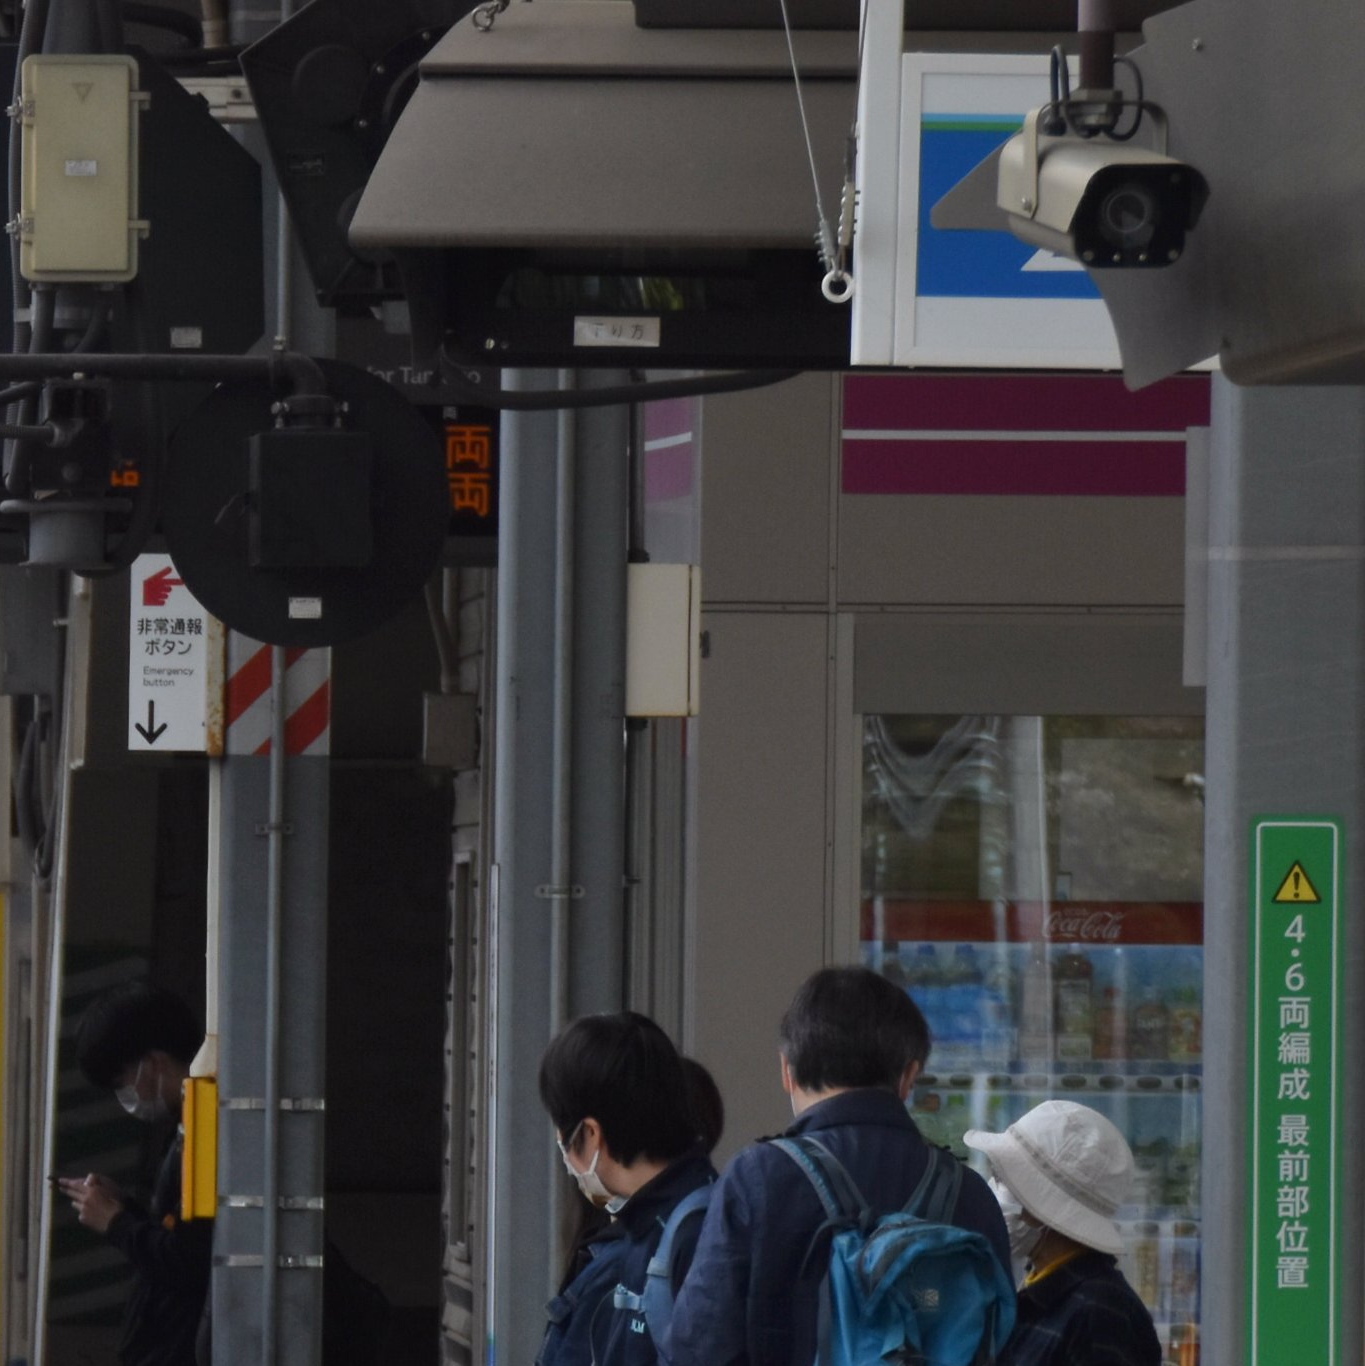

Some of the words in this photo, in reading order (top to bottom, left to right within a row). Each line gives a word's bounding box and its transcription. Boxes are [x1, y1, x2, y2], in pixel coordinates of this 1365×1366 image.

[445, 425, 491, 469] 両
[136, 617, 203, 636] 非常通報
[144, 638, 192, 656] ボタン
[142, 665, 195, 677] Emergency
[142, 678, 176, 687] button
[1275, 1114, 1311, 1290] 最前部位置
